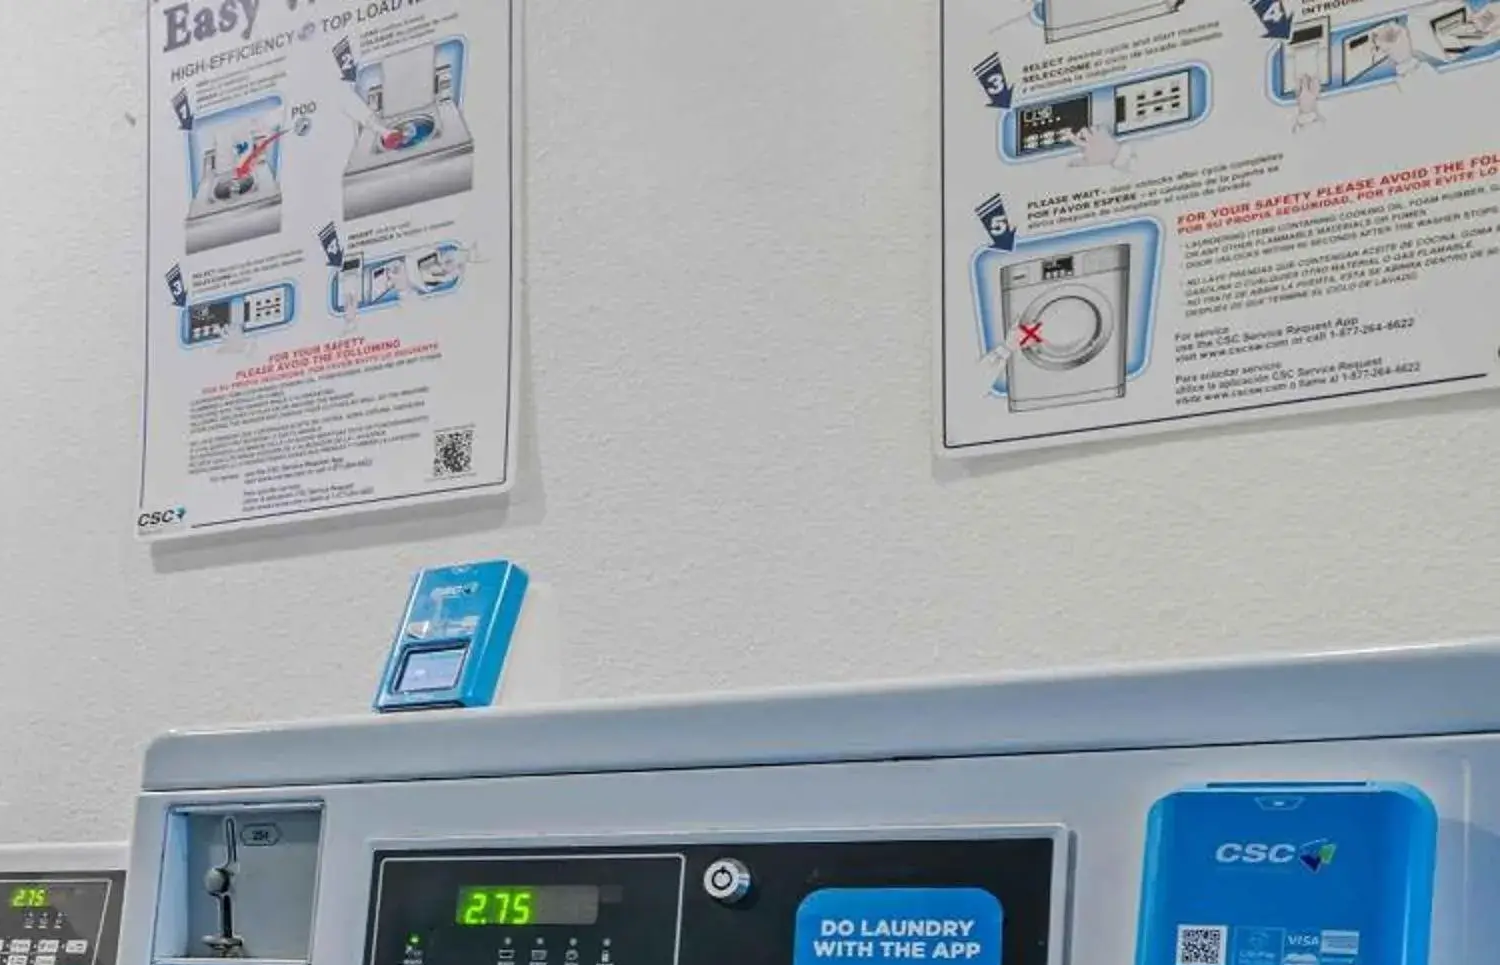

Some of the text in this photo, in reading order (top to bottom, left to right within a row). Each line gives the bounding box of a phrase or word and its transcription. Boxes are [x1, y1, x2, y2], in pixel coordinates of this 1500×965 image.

[322, 12, 352, 32] TOP
[1263, 2, 1284, 22] 4
[163, 0, 259, 52] Easy
[987, 73, 1005, 94] 3
[291, 101, 317, 118] POD
[1027, 194, 1068, 208] PLEASE
[1177, 209, 1206, 223] FOR
[1210, 201, 1250, 217] YOUR
[1256, 189, 1311, 208] SAFETY
[1317, 178, 1375, 197] PLEASE
[1380, 168, 1428, 185] AVOID
[1435, 161, 1465, 175] THE
[1177, 222, 1201, 234] POR
[1357, 188, 1382, 200] POR
[1388, 179, 1432, 195] FAVOR
[1435, 171, 1475, 186] EVITE
[1480, 166, 1498, 177] LO
[990, 215, 1008, 237] 5
[172, 282, 182, 296] 3
[1216, 334, 1240, 345] CSC
[1286, 321, 1333, 337] Request
[1335, 318, 1359, 330] App
[137, 510, 174, 527] CSC
[1216, 843, 1296, 864] CSC
[464, 892, 532, 925] 2.75
[821, 919, 976, 937] DO LAUNDRY
[813, 941, 981, 960] WITH THE APP
[1288, 935, 1319, 946] VISA
